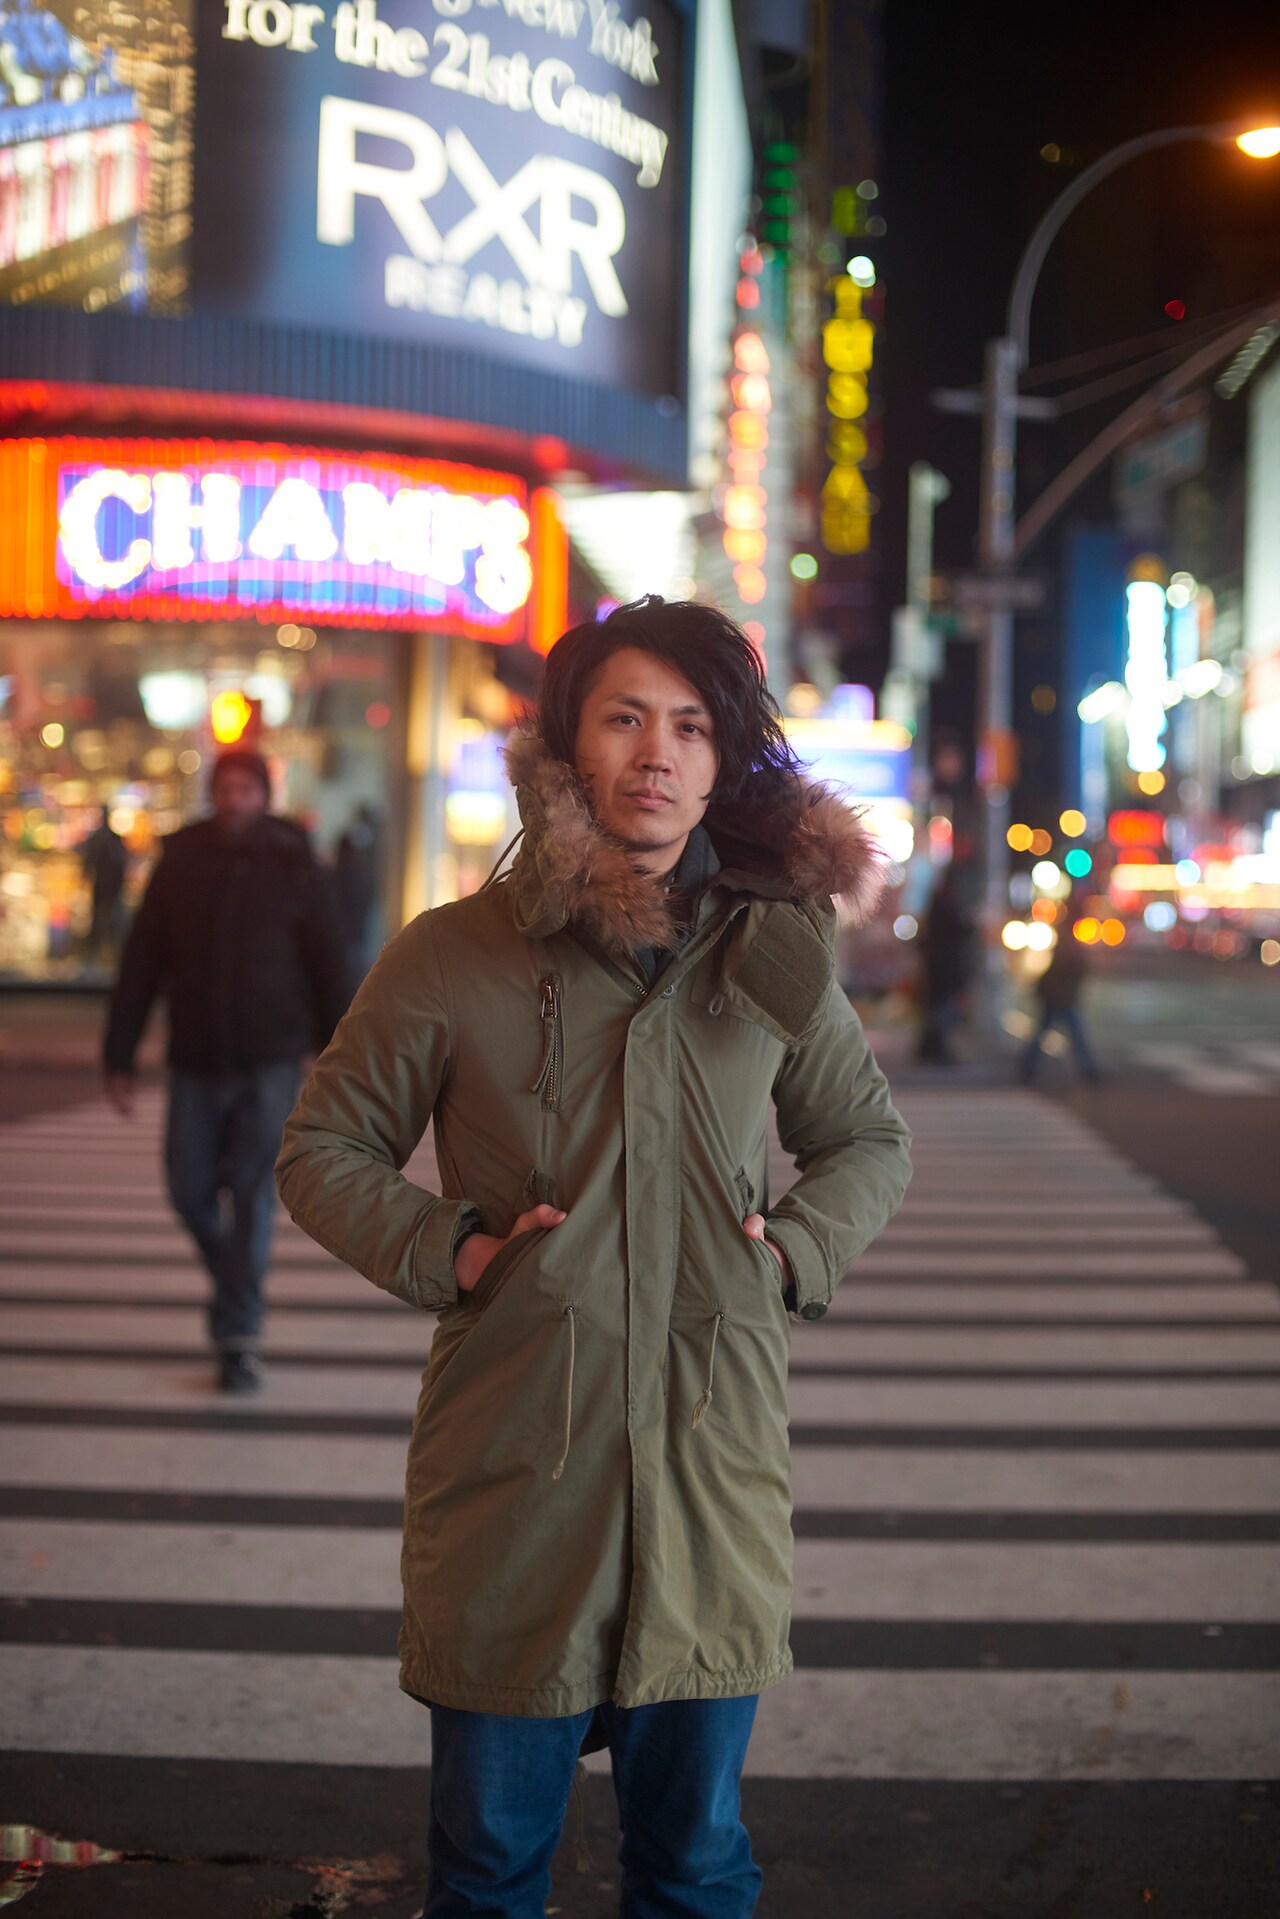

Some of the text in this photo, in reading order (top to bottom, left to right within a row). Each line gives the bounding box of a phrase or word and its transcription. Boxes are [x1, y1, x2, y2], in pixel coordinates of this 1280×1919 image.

[331, 0, 430, 78] the
[430, 22, 532, 112] 21st
[531, 57, 668, 188] Century
[317, 95, 629, 318] RXR
[384, 253, 587, 348] REALTY
[58, 469, 531, 614] CHAMPS
